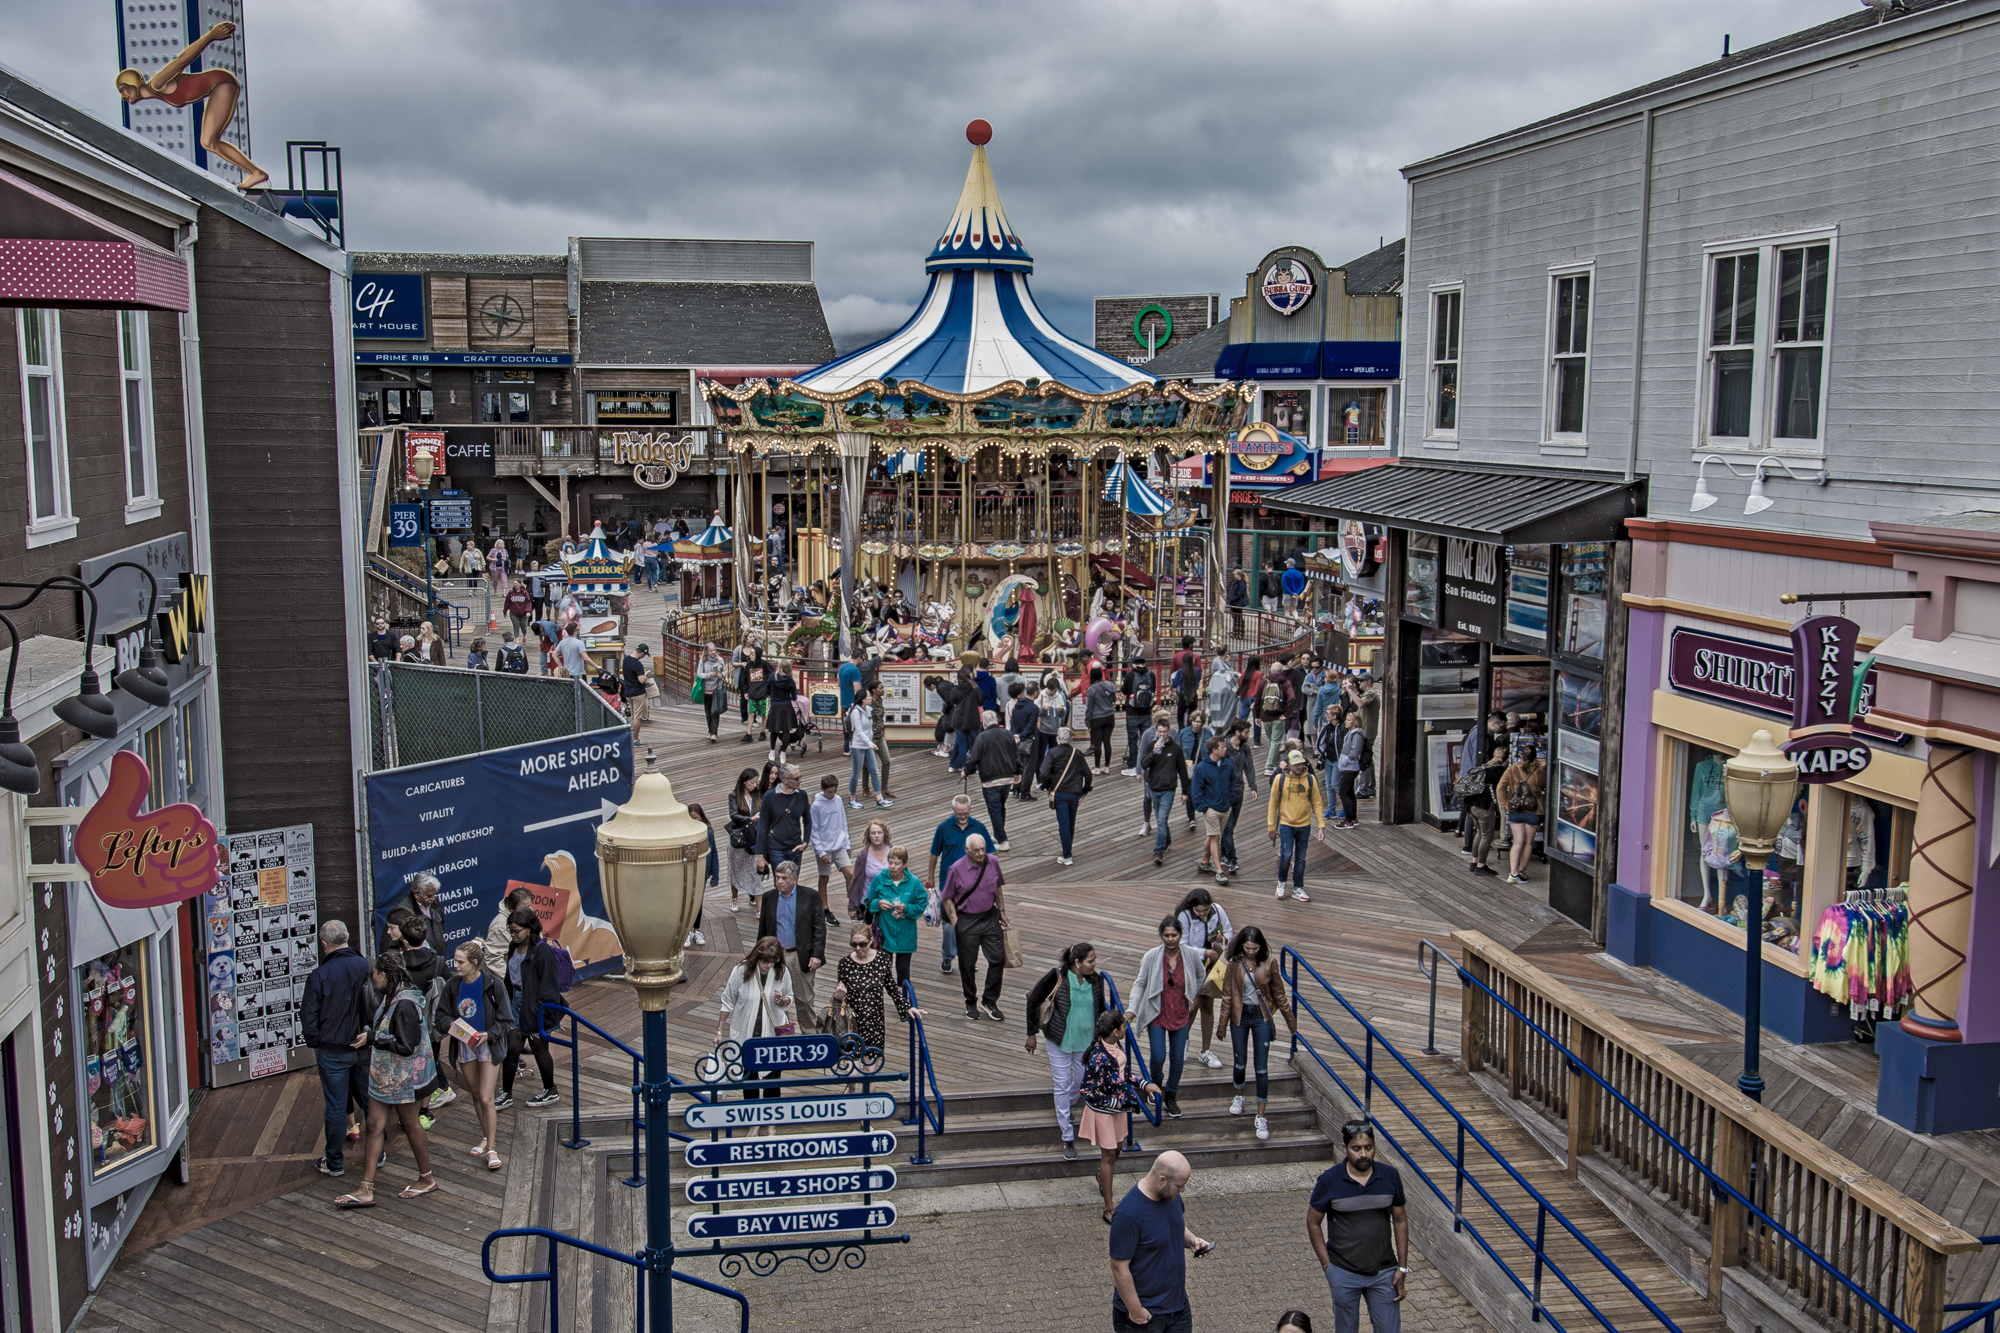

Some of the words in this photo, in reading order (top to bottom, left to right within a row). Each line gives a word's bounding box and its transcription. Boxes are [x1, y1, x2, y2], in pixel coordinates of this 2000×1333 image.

[1264, 285, 1288, 294] BUBBA
[1289, 284, 1310, 293] GUMP
[356, 282, 395, 318] CH
[1278, 399, 1297, 407] LATE
[410, 438, 441, 446] FUNNEL
[630, 431, 646, 442] The
[447, 443, 491, 457] CAFFÈ
[613, 432, 694, 474] Fudgery
[1231, 442, 1285, 453] PLAYERS
[394, 511, 416, 520] PIER
[394, 520, 417, 538] 39
[570, 565, 624, 575] CHURROS
[1446, 537, 1474, 580] IMAGE
[1475, 541, 1498, 585] ARTS
[1445, 583, 1459, 596] San
[1461, 586, 1496, 605] Francisco
[1820, 626, 1841, 717] KRAZY
[520, 755, 566, 776] MORE
[570, 742, 620, 766] SHOPS
[1790, 747, 1868, 774] KAPS
[405, 776, 465, 797] CARICATURES
[568, 767, 620, 792] AHEAD
[419, 807, 455, 822] VITALITY
[95, 826, 207, 878] Lefty's
[382, 838, 444, 860] BUILD-A-BEAR
[446, 826, 494, 845] WORKSHOP
[404, 867, 437, 884] HIEN
[439, 857, 478, 875] DRAGON
[435, 890, 461, 902] TMAS
[464, 886, 473, 896] IN
[444, 899, 479, 915] NCISCO
[443, 927, 471, 942] DGERY
[256, 1054, 280, 1064] ALWAYS
[259, 1050, 276, 1058] DOGS
[754, 1046, 804, 1064] PIER
[806, 1044, 829, 1061] 39
[253, 1060, 284, 1071] WELCOME
[725, 1106, 785, 1123] SWISS
[791, 1103, 847, 1120] LOUIS
[730, 1139, 849, 1161] RESTROOMS
[717, 1181, 775, 1198] LEVEL
[781, 1180, 791, 1194] 2
[797, 1175, 861, 1193] SHOPS
[737, 1217, 773, 1234] BAY
[778, 1213, 839, 1230] VIEWS
